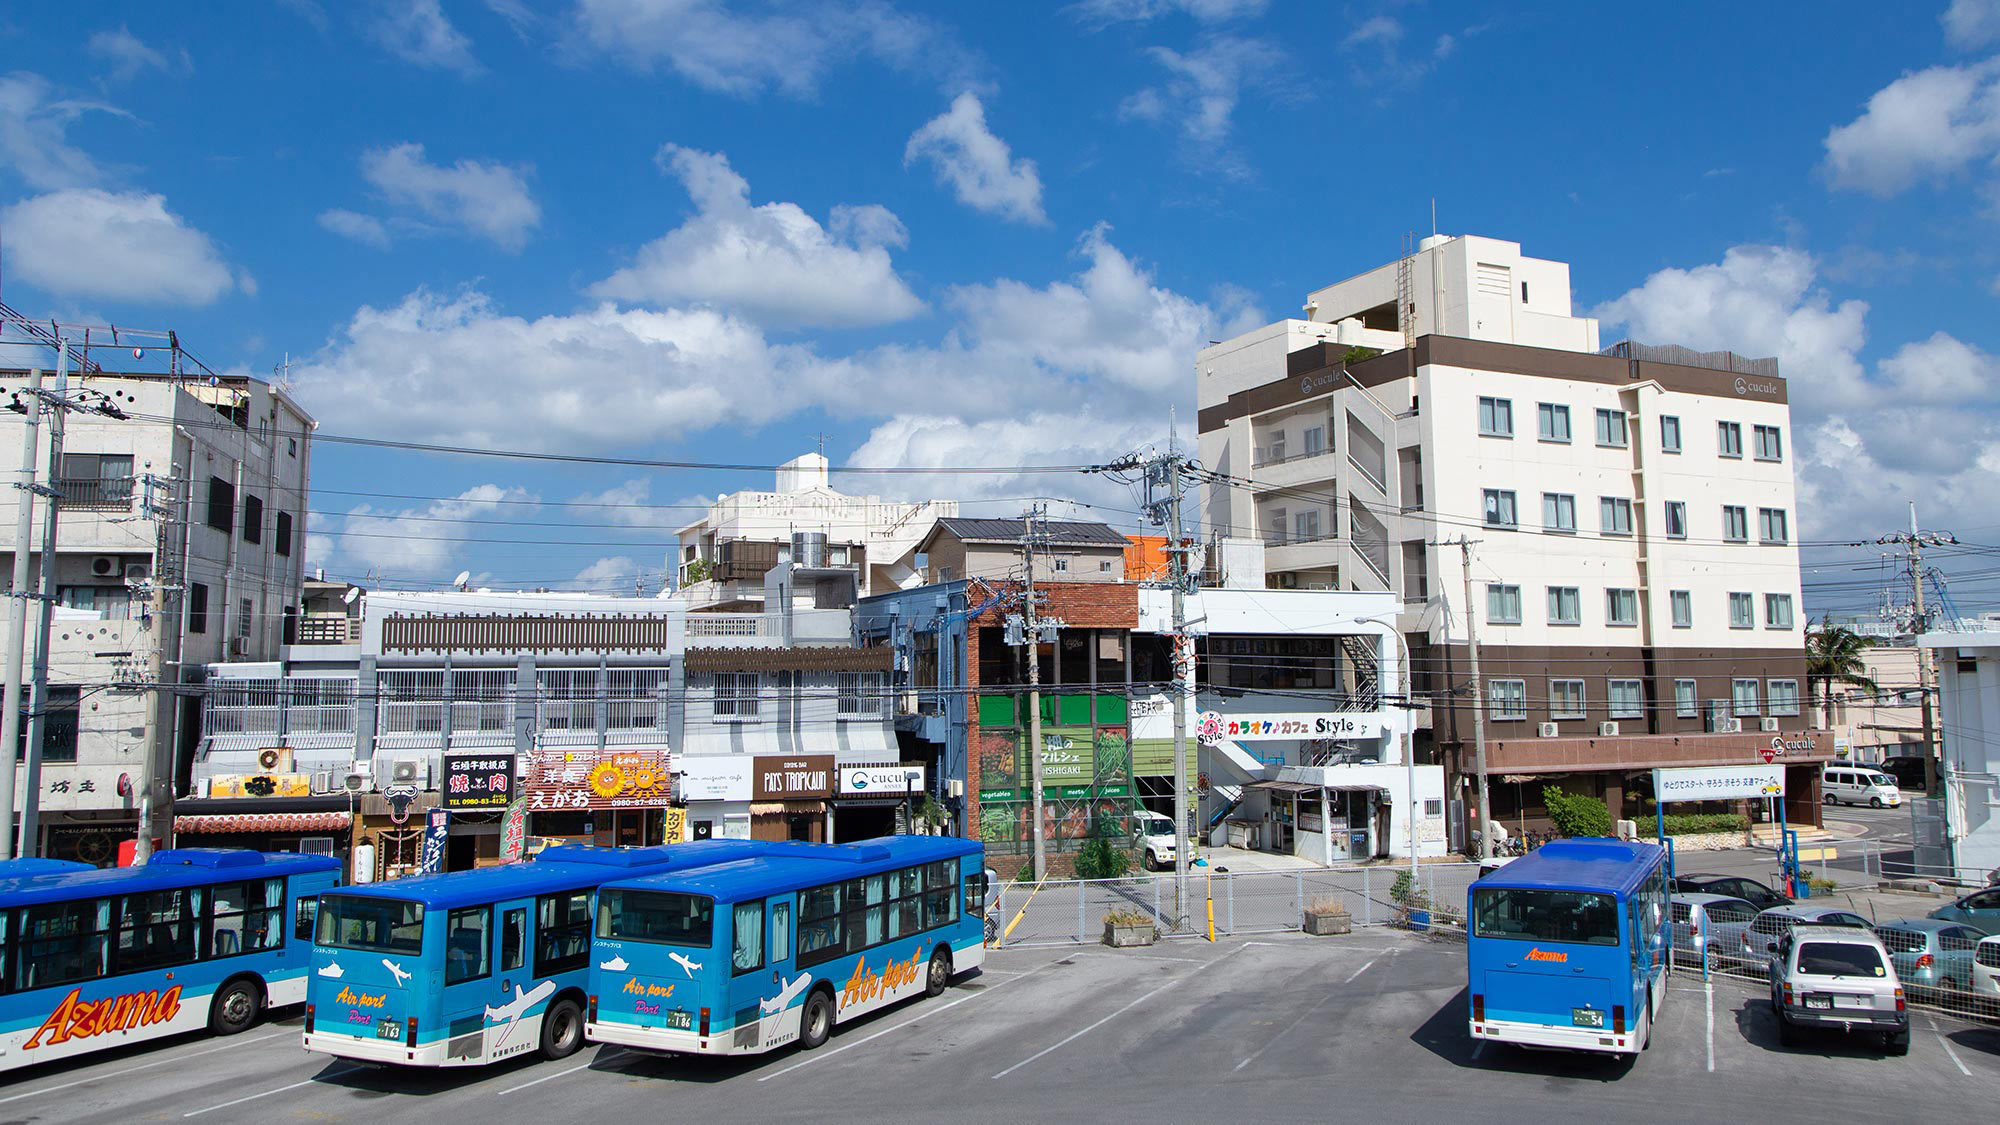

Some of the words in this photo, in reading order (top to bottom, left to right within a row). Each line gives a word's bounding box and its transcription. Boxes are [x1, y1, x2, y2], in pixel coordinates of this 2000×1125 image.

[1313, 370, 1341, 386] cucule
[1748, 382, 1777, 394] cucule
[1315, 718, 1354, 735] Style
[1197, 731, 1223, 744] Style
[1785, 737, 1816, 749] cucule
[451, 760, 507, 770] 石垣牛取扱店
[616, 756, 639, 765] えがお
[1041, 752, 1080, 763] マルシェ
[764, 772, 782, 792] PAYS
[871, 771, 907, 783] cucul
[462, 797, 507, 805] 0980-83-4129
[531, 789, 591, 809] えがお
[982, 791, 1011, 799] vegetables
[504, 809, 524, 860] 石垣牛
[1524, 947, 1568, 963] Azuma
[841, 954, 880, 1009] Air
[880, 946, 922, 1000] port
[622, 976, 645, 995] Air
[646, 984, 675, 998] port
[336, 986, 358, 1005] Air
[358, 992, 387, 1008] port
[635, 1000, 660, 1014] Port
[22, 984, 183, 1051] Azuma
[348, 1009, 371, 1024] Port
